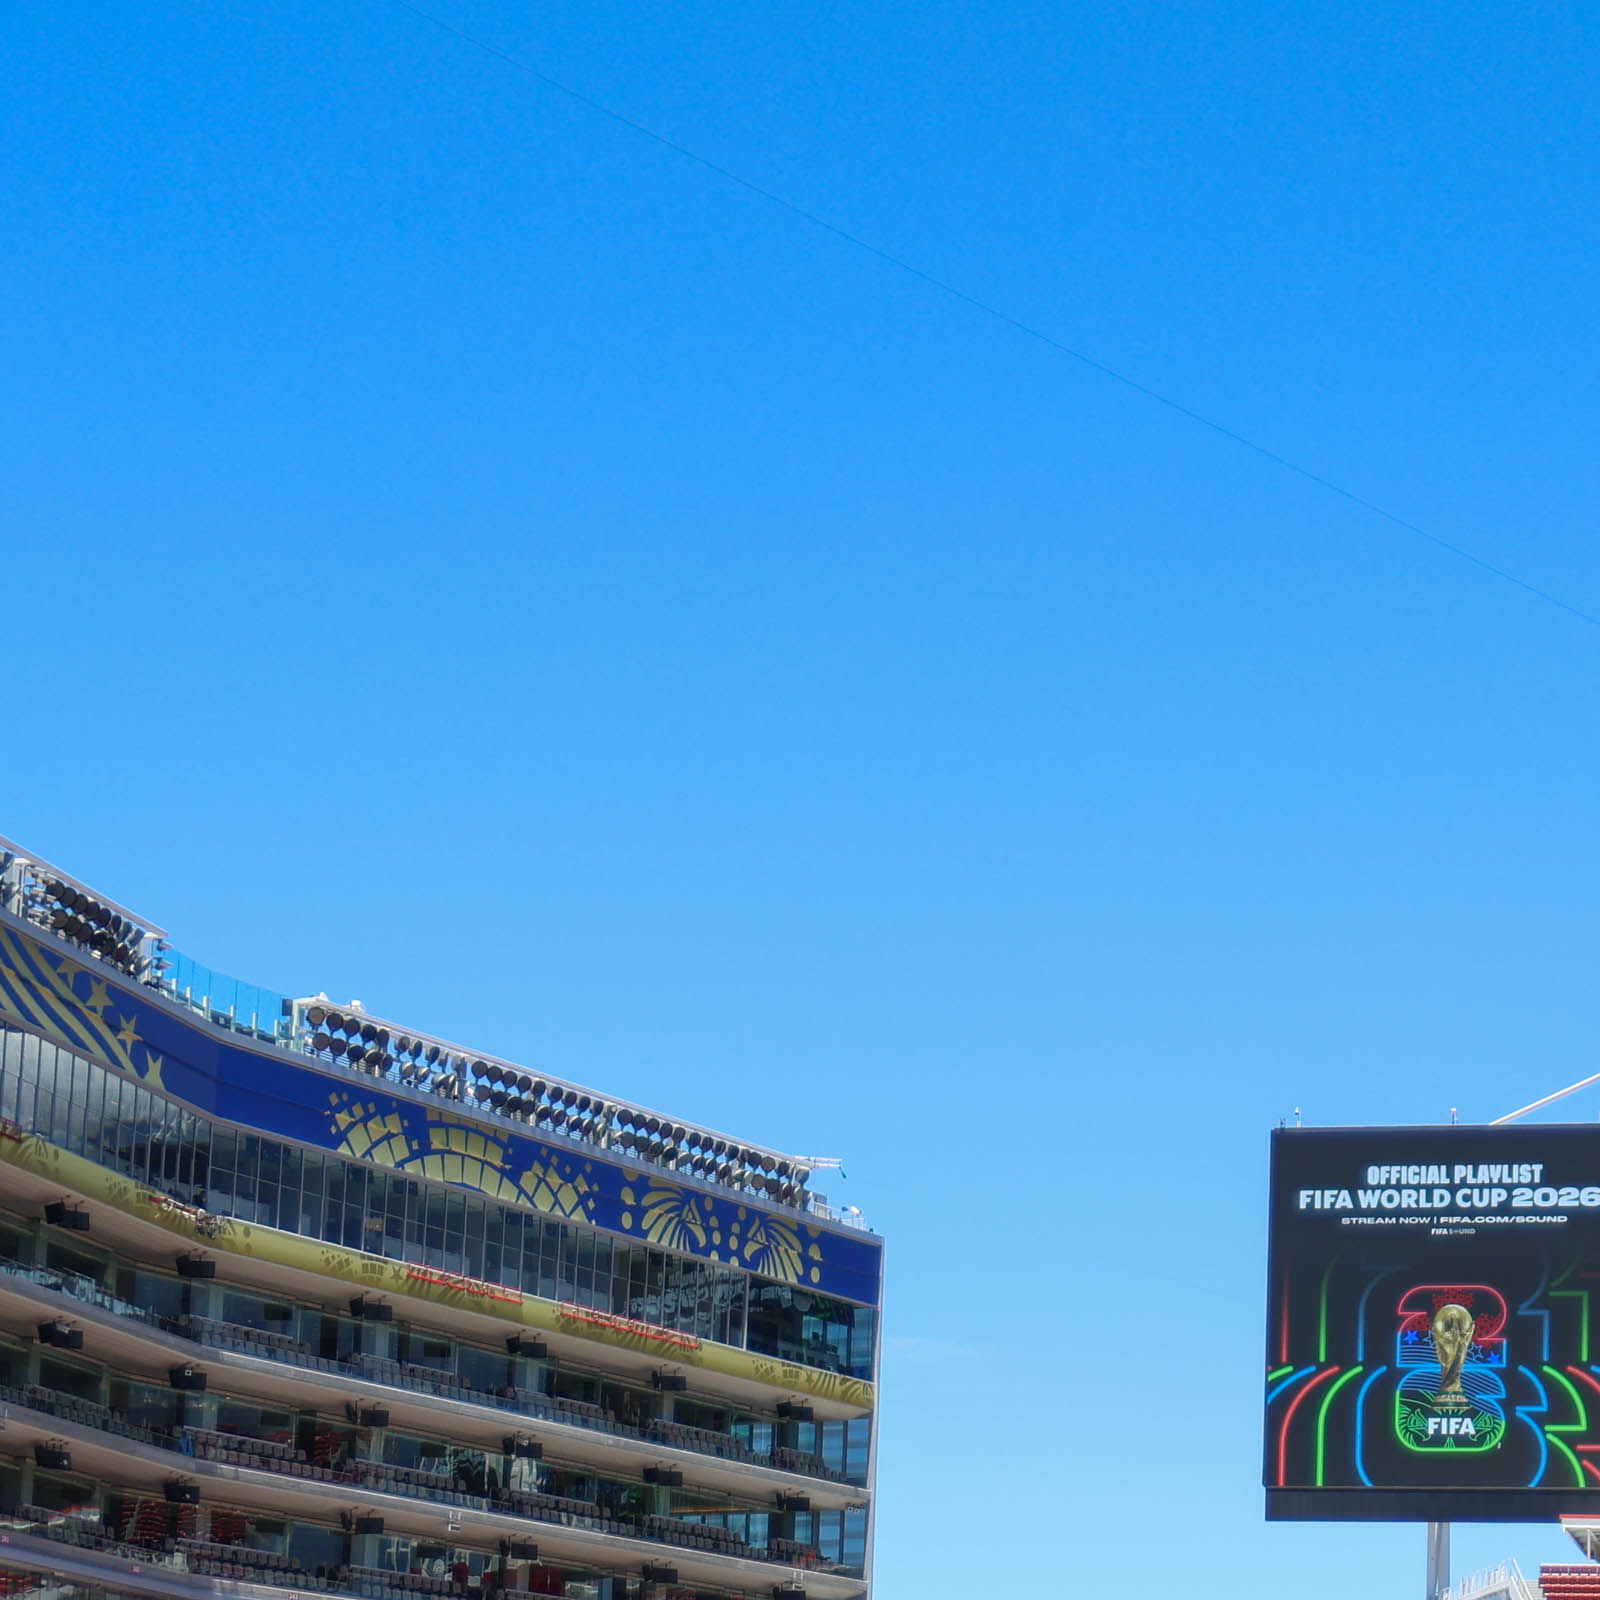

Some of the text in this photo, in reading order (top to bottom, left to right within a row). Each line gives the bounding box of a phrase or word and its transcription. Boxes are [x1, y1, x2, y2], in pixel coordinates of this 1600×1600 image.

[1367, 1164, 1542, 1185] OFFICIAL PLAYLIST
[1299, 1190, 1353, 1209] FIFA
[1357, 1189, 1450, 1208] WORLD
[1456, 1188, 1508, 1208] CUP
[1440, 1216, 1568, 1224] FIFA.COM/SOUND
[1427, 1417, 1476, 1434] FIFA
